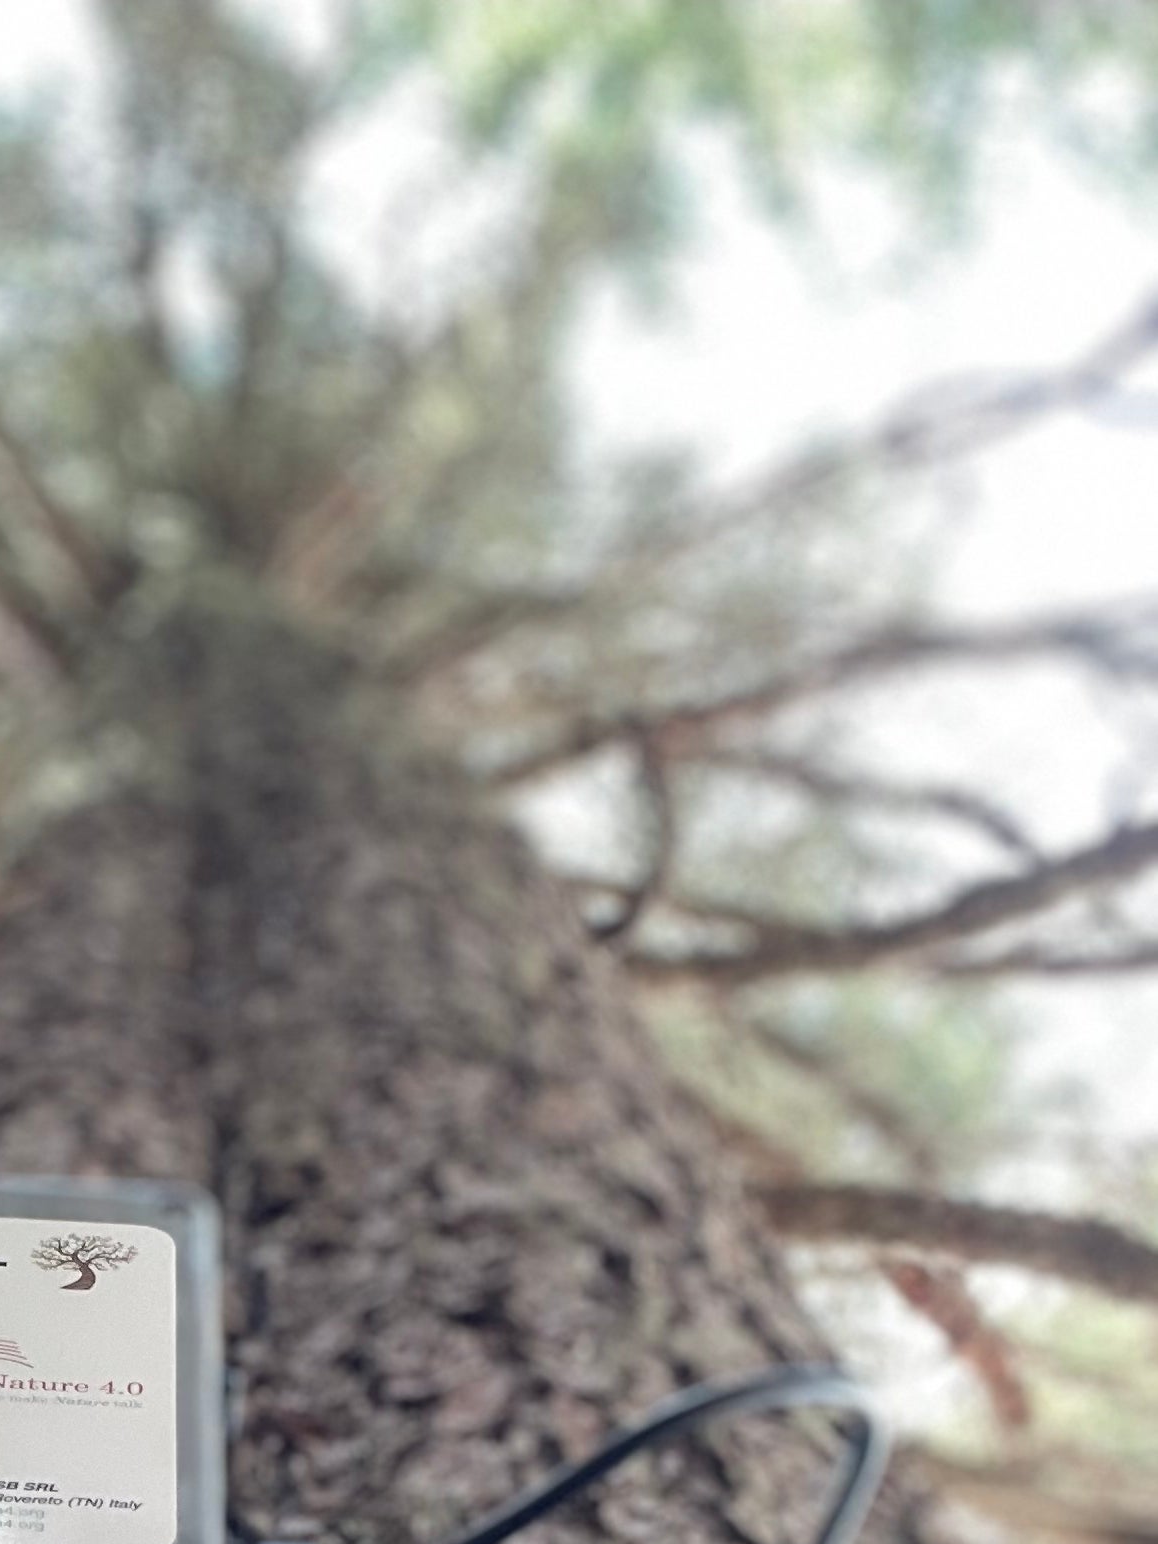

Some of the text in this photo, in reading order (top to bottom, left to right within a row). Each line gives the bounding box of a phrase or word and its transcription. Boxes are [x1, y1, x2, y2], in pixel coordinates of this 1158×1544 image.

[99, 1380, 144, 1396] 4.0
[23, 1482, 59, 1493] SRL
[68, 1496, 104, 1510] (TN)
[109, 1498, 143, 1512] Italy
